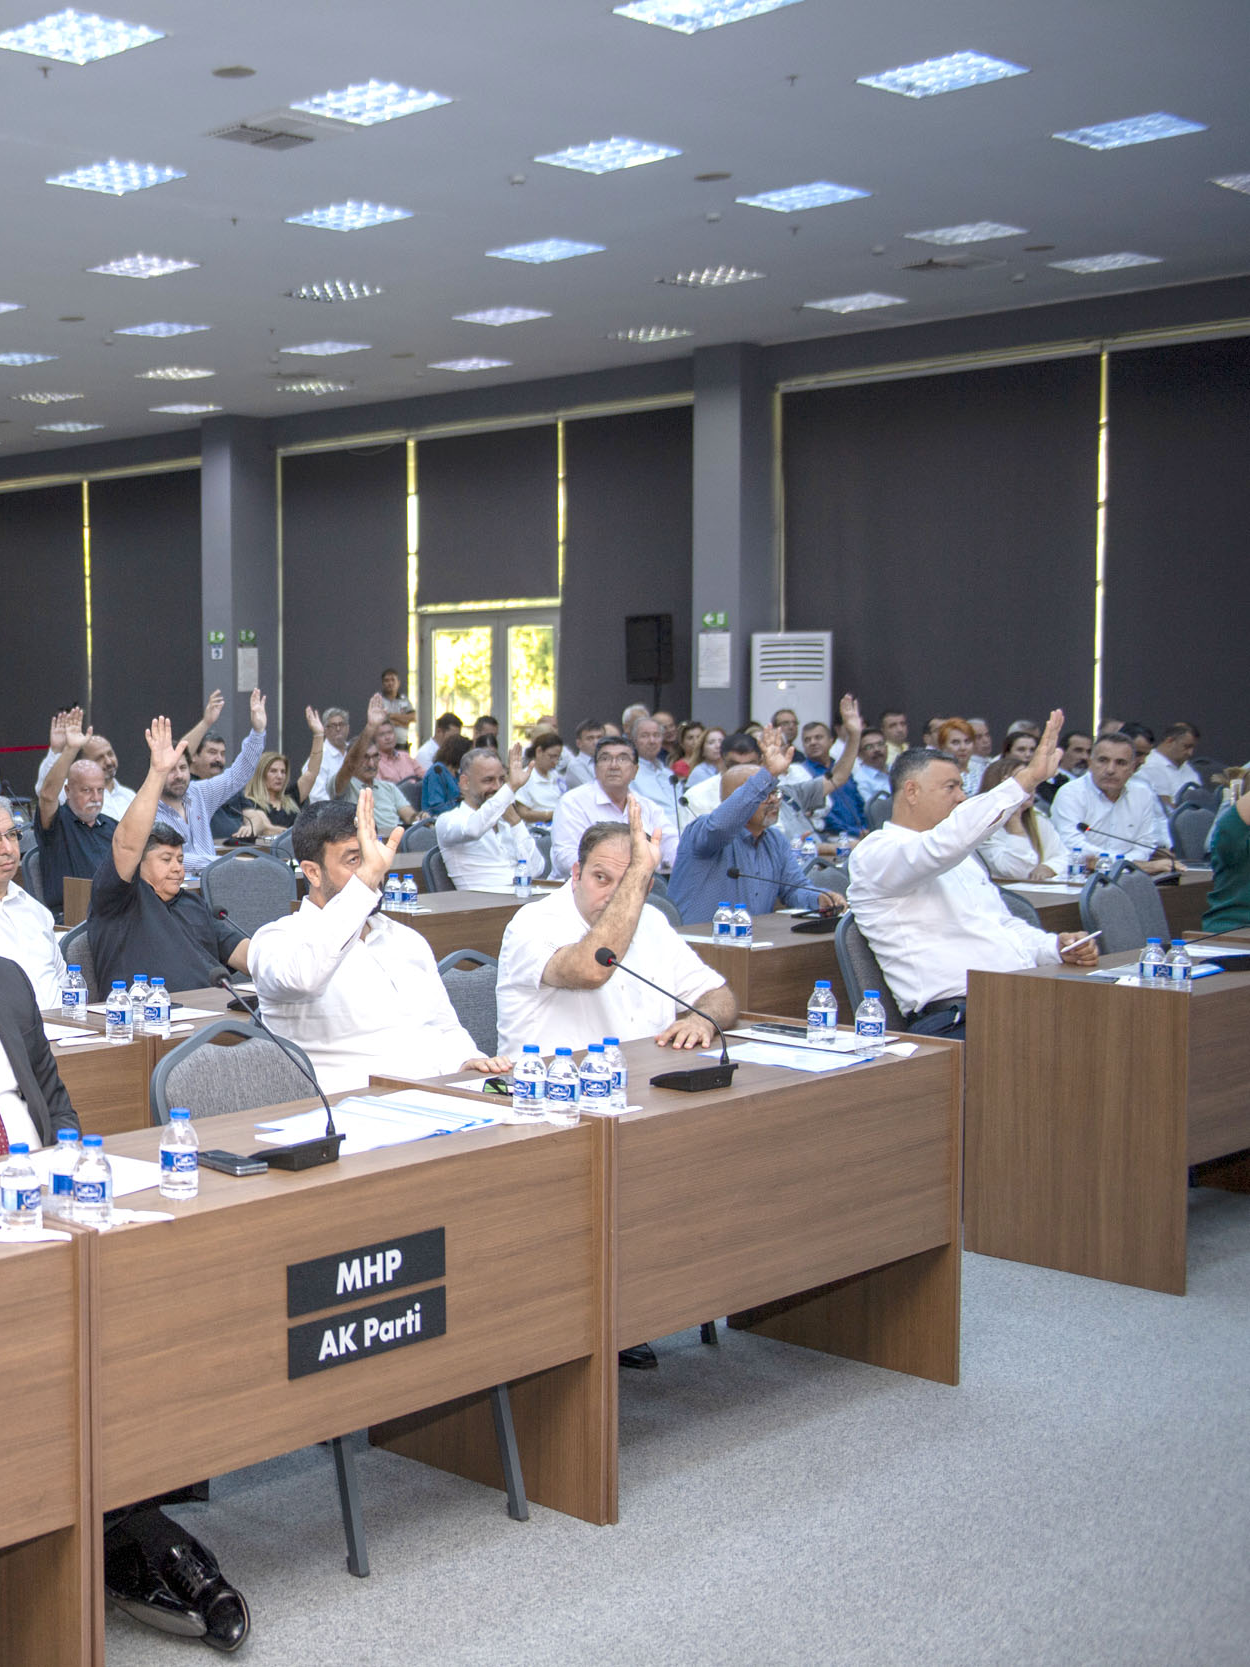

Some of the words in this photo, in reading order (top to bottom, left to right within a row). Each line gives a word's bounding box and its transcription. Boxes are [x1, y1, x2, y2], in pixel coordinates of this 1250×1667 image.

[336, 1249, 402, 1294] MHP
[318, 1323, 358, 1361] AK
[364, 1303, 421, 1347] Parti
